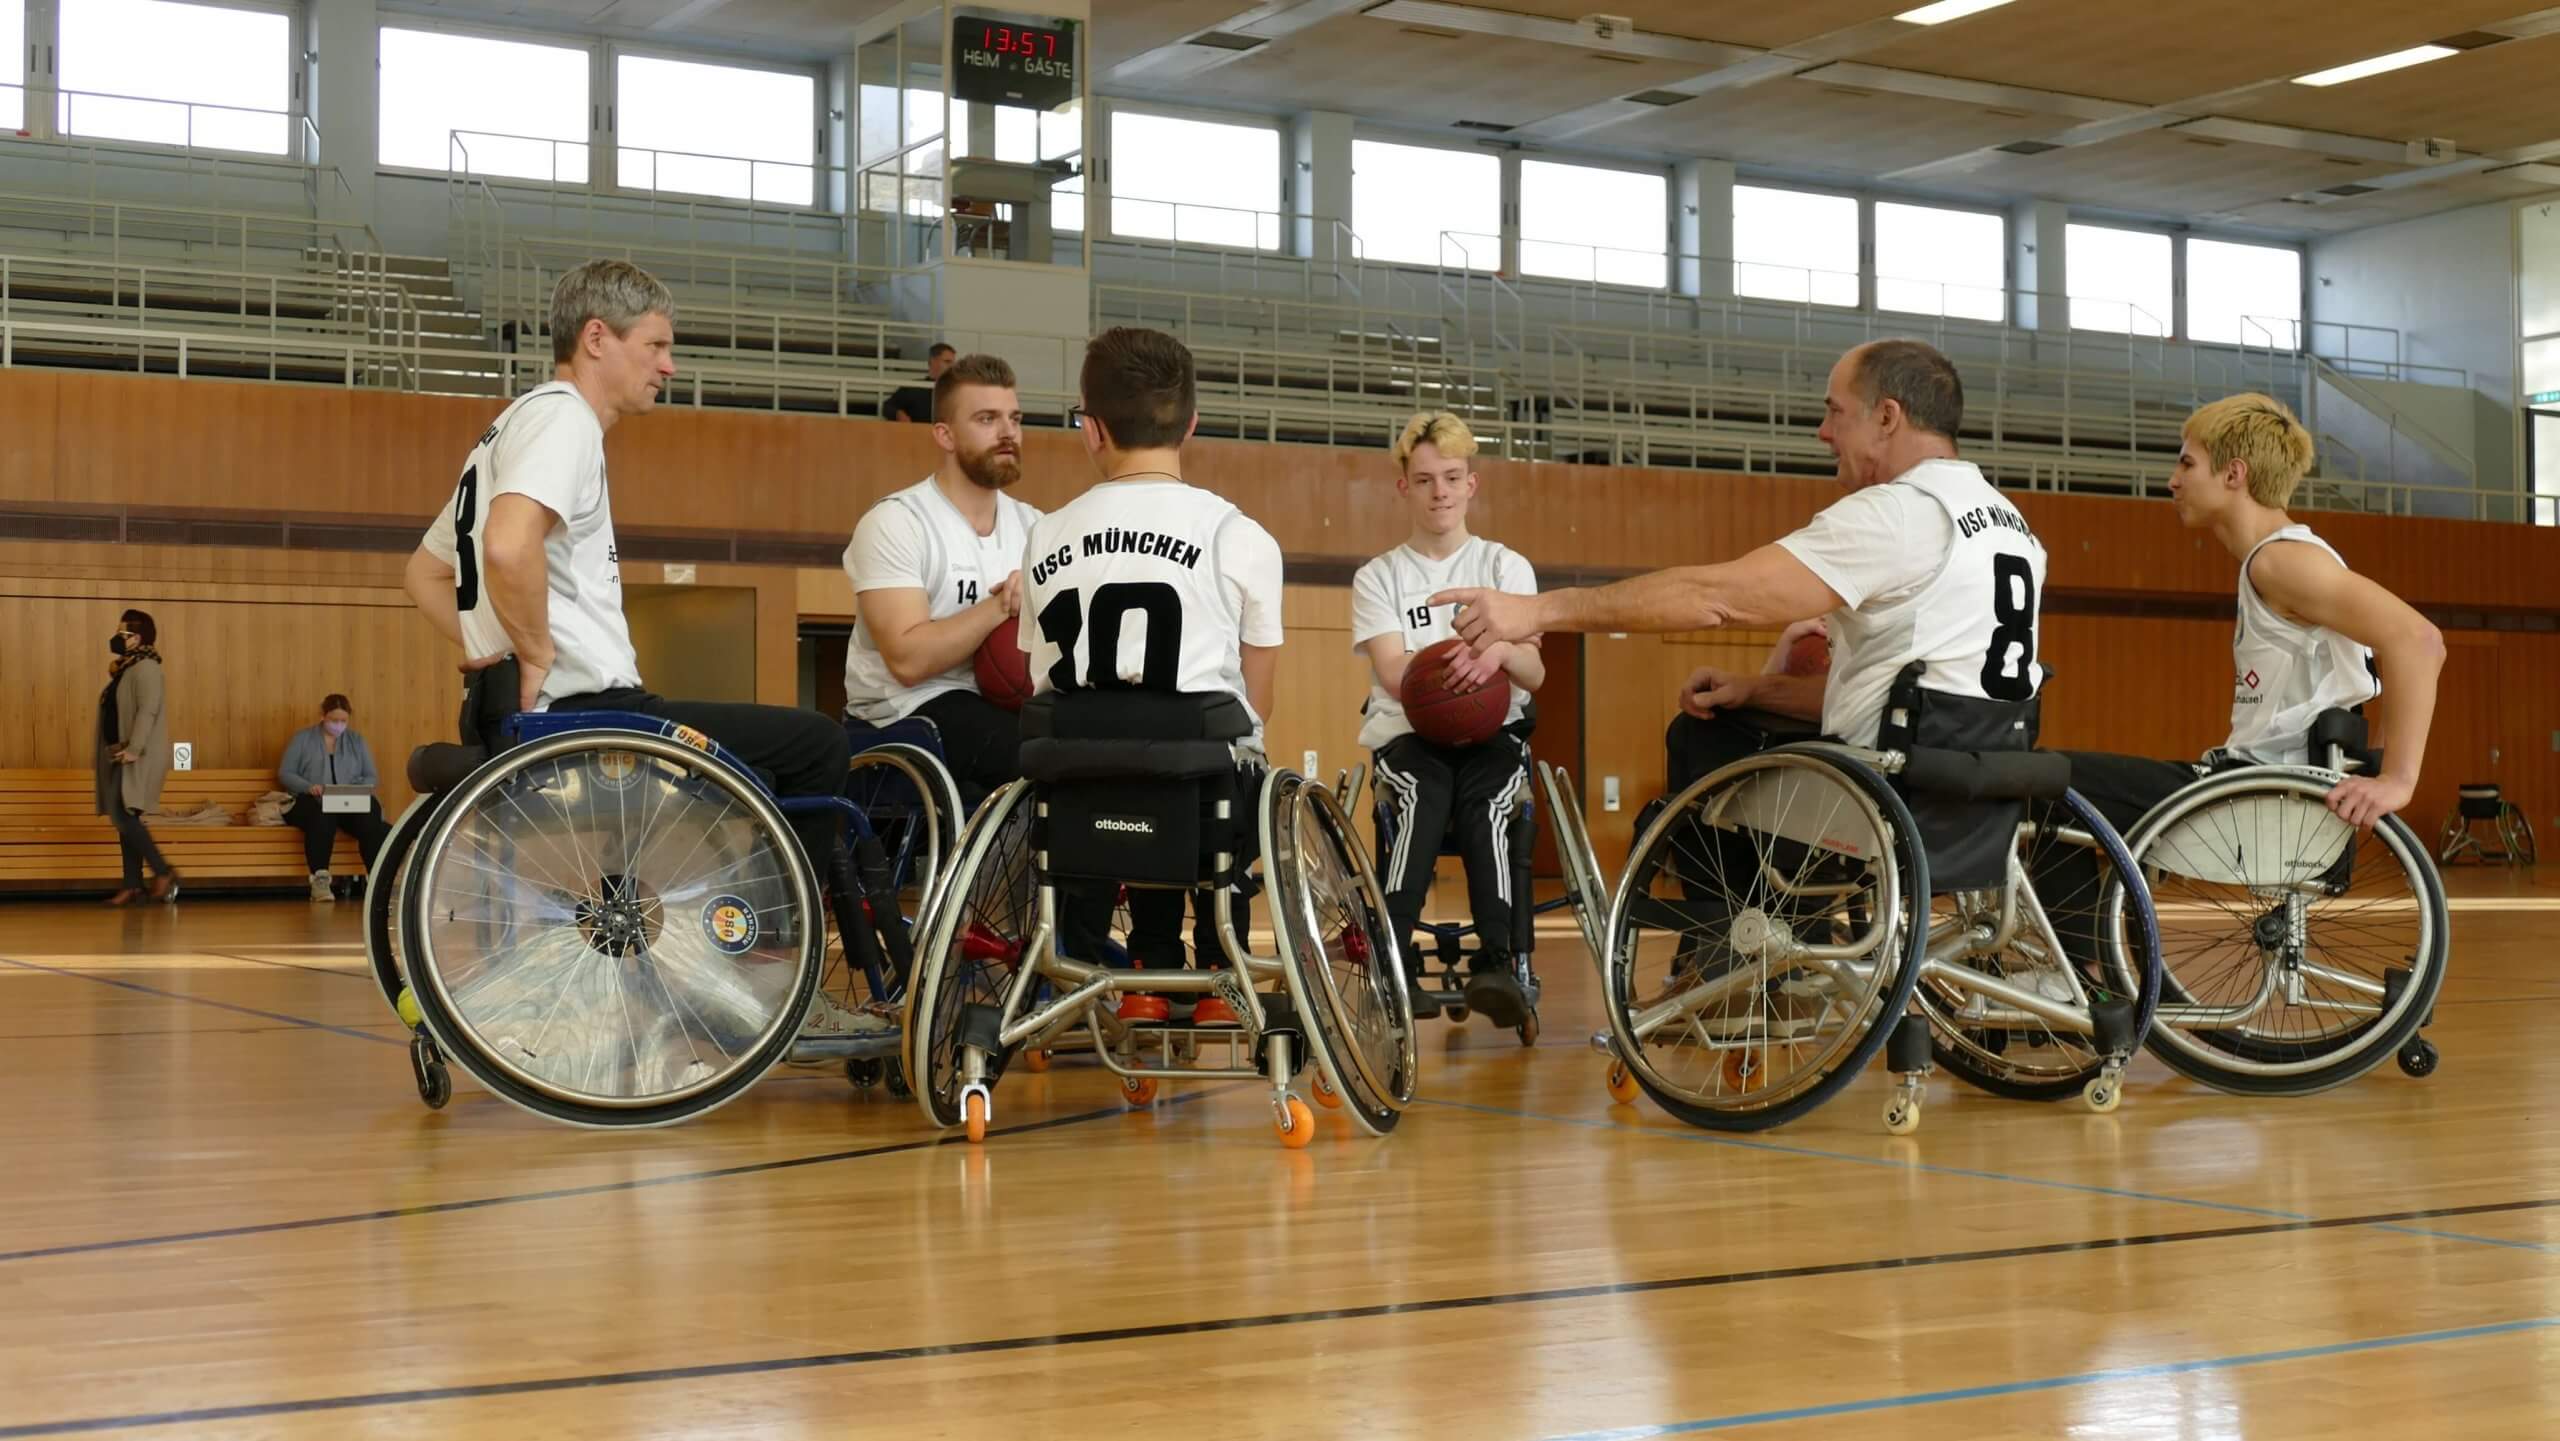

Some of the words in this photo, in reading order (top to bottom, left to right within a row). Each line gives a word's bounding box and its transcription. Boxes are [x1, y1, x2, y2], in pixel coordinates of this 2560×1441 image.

[983, 26, 1056, 57] 13:57
[963, 48, 1000, 69] HEIM
[1956, 507, 1987, 538] USC
[1032, 545, 1073, 586] USC
[1082, 527, 1202, 570] MÜNCHEN
[957, 579, 978, 605] 14
[1406, 606, 1431, 629] 19
[1980, 552, 2034, 701] 8
[1037, 582, 1182, 692] 10
[1095, 819, 1153, 833] ottobock.
